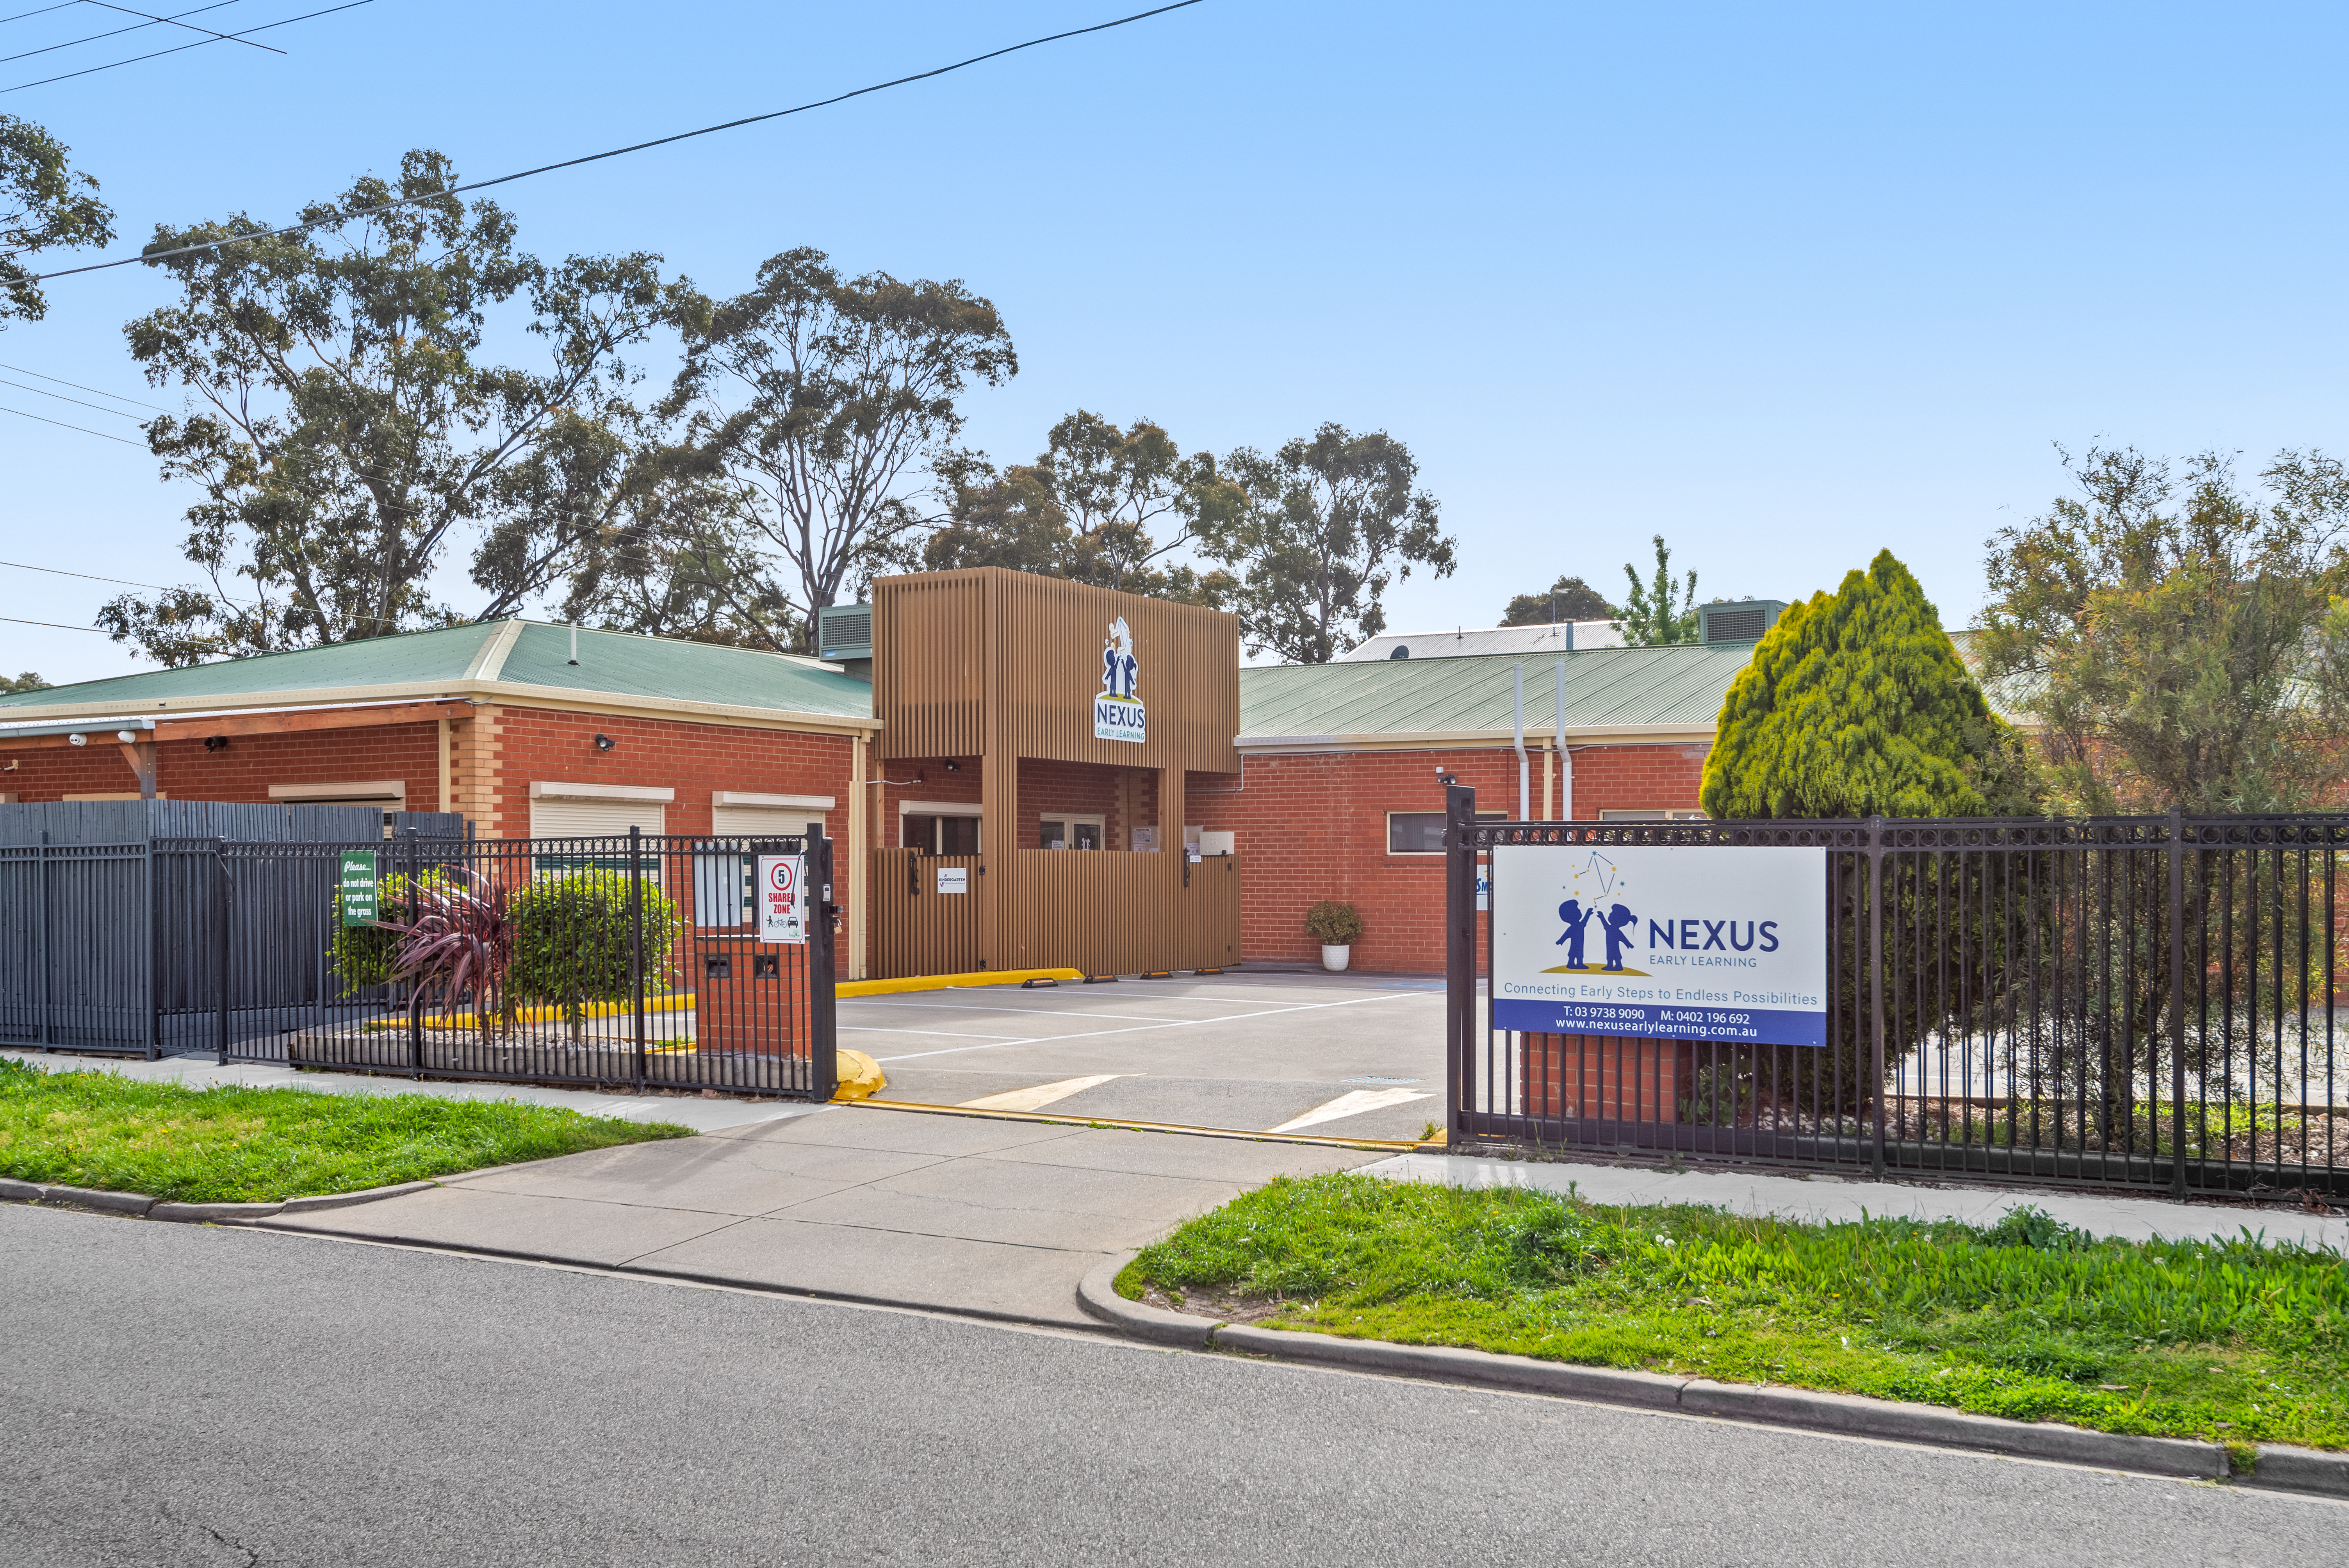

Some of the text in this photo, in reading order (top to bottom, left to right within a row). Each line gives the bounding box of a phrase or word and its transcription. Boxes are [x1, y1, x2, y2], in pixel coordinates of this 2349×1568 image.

[1098, 702, 1144, 728] NEXUS
[1097, 727, 1144, 739] EARLY LEARNING
[343, 877, 374, 887] do not drive
[778, 870, 785, 884] 5
[352, 891, 364, 904] park
[768, 893, 795, 902] SHARED
[348, 905, 371, 918] the grass
[773, 904, 790, 914] ZONE
[1650, 918, 1779, 952] NEXUS
[1650, 955, 1757, 968] EARLY LEARNING
[1504, 982, 1817, 1005] Connecting Early Steps to Endless Possibilities
[1563, 1006, 1750, 1024] T: 03 9738 9090 M: 0402 196 692
[1556, 1019, 1757, 1037] www.nexusearlylearning.com.au
